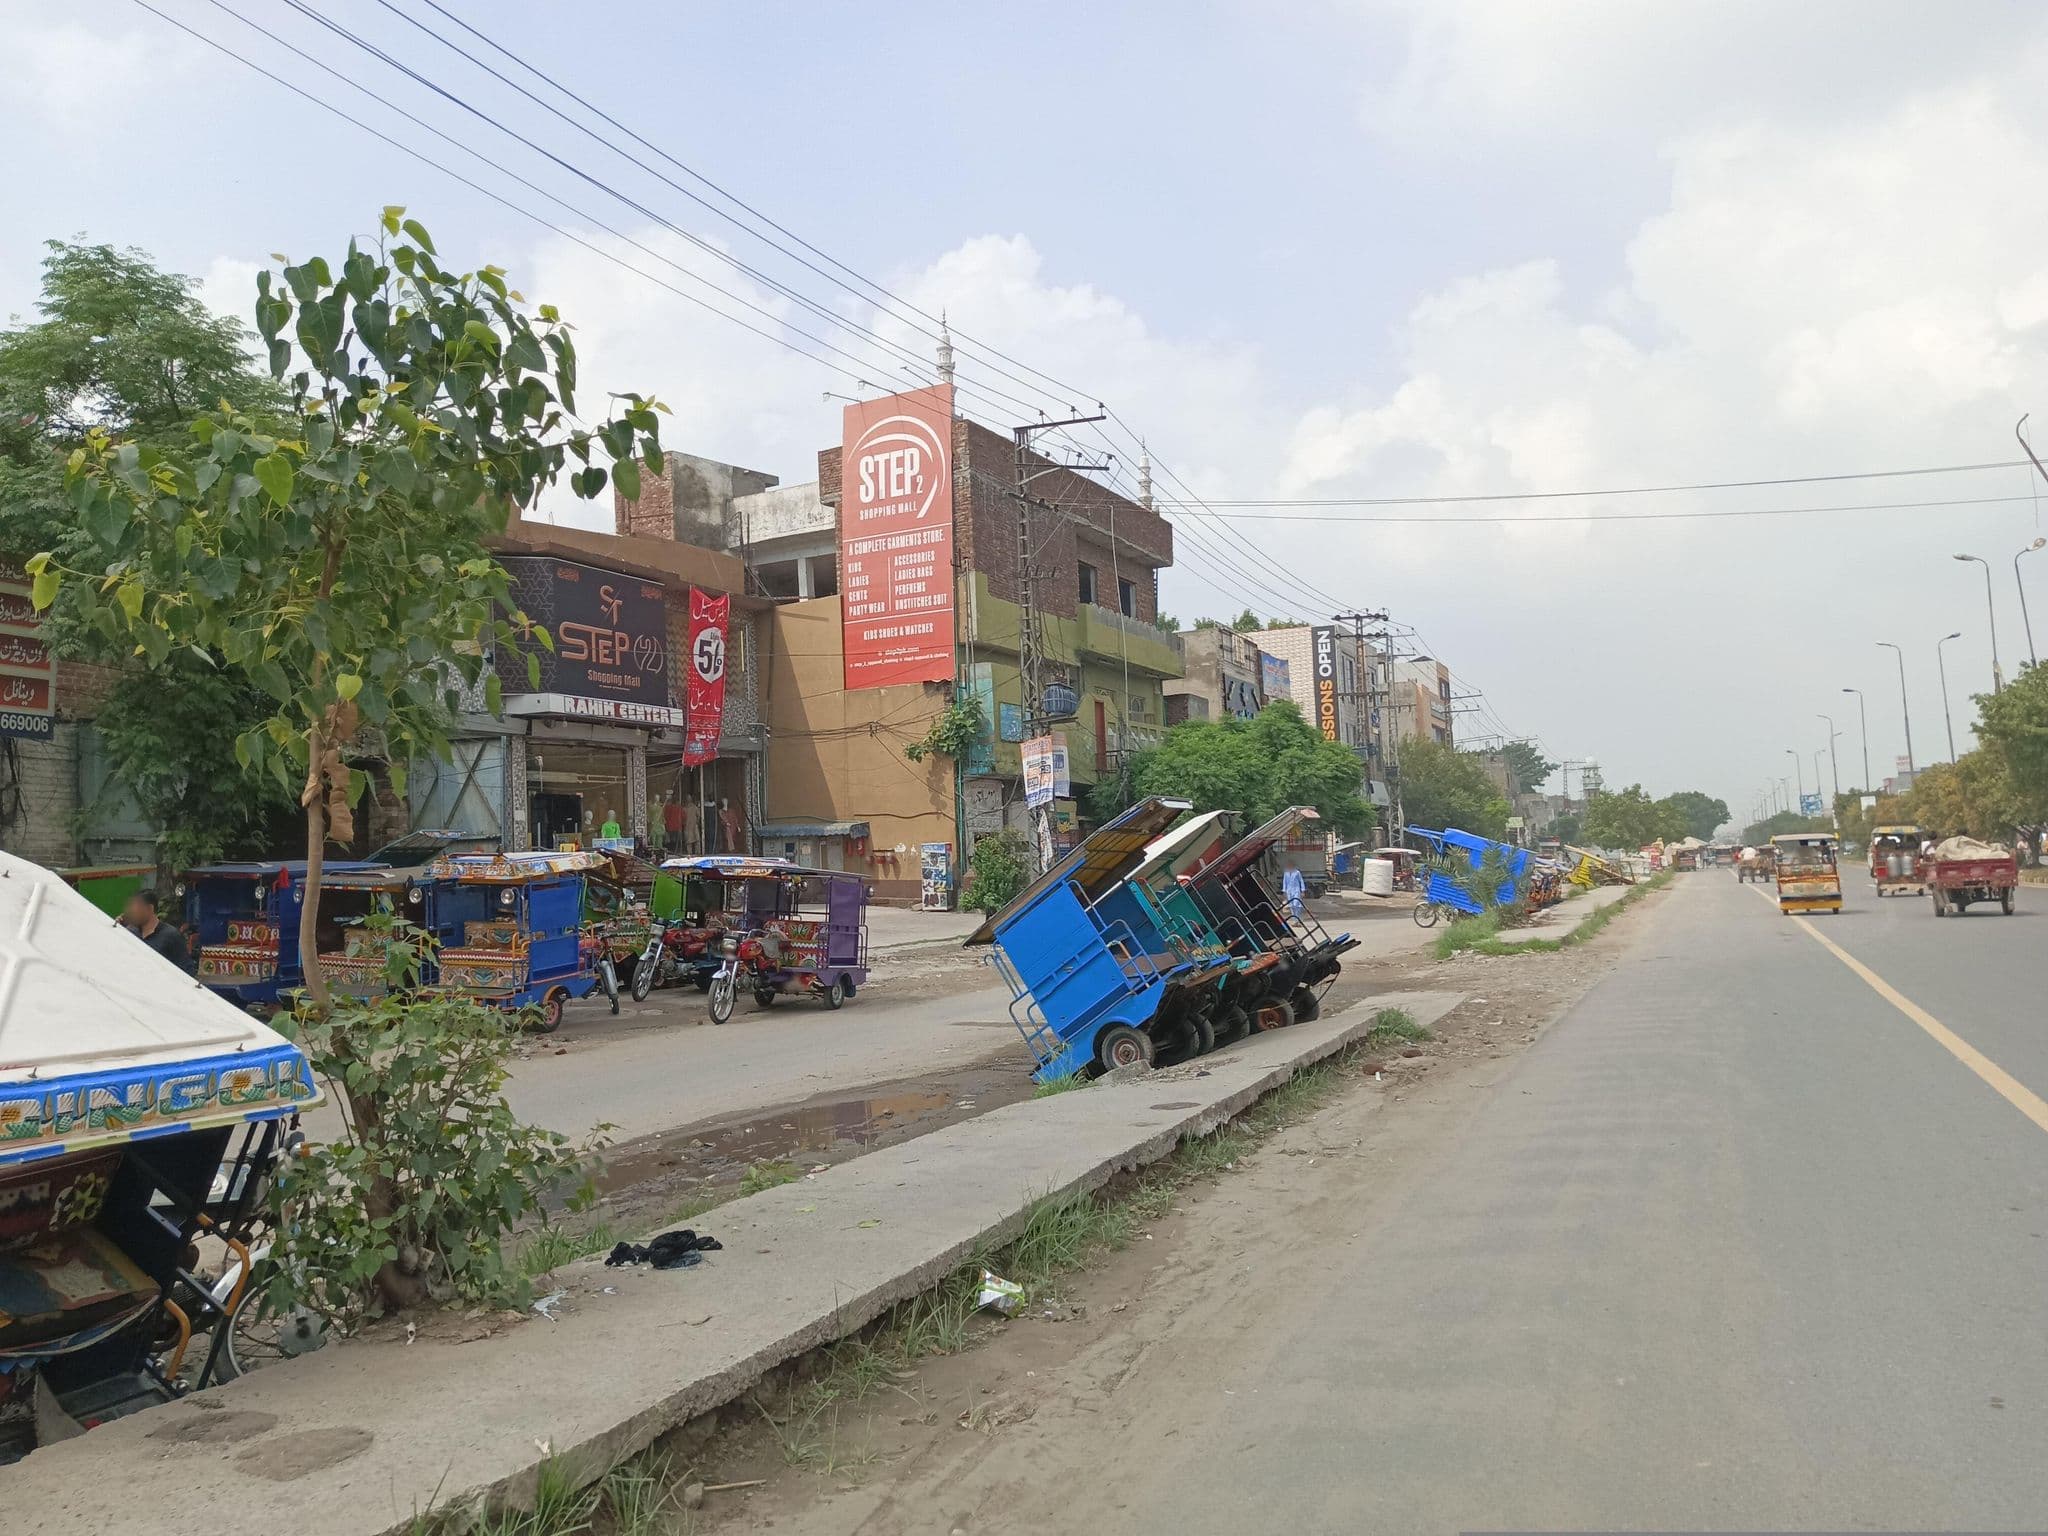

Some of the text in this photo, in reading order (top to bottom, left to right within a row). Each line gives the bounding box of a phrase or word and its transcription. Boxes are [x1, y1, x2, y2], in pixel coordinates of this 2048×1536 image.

[860, 447, 920, 503] STEP
[860, 501, 917, 520] SHOPPING MALL
[848, 543, 854, 556] A
[854, 538, 886, 555] COMPLETE
[887, 532, 922, 550] GARMENTS
[894, 550, 935, 566] ACCESSORIES
[848, 575, 869, 588] LADIES
[895, 565, 933, 581] LADIES BAGS
[848, 601, 885, 616] PARTY WEAR
[933, 593, 947, 606] SUIT
[863, 623, 933, 640] KIDS SHOES & WATCHES
[559, 621, 630, 666] STEP
[1317, 629, 1333, 677] OPEN
[587, 669, 623, 687] Shopping
[624, 674, 641, 688] Mall
[565, 696, 670, 724] RAHIM CENTER
